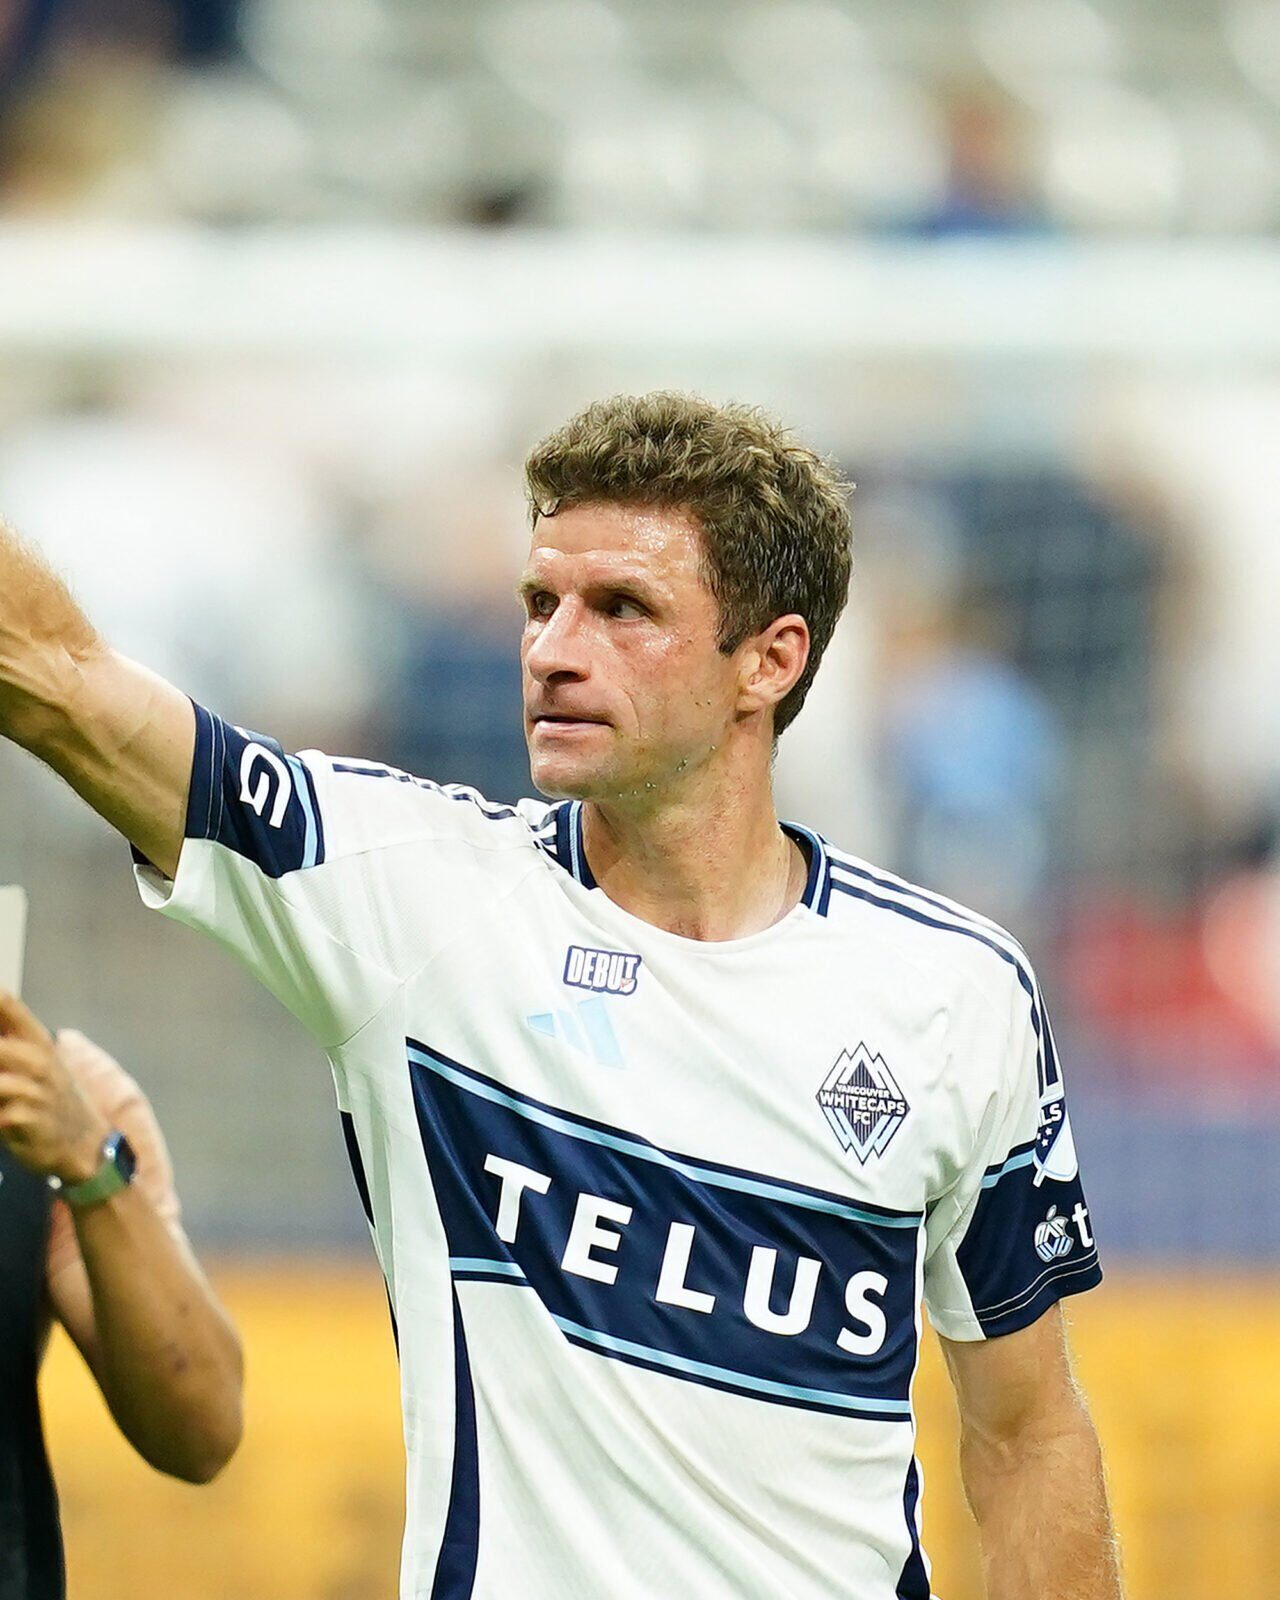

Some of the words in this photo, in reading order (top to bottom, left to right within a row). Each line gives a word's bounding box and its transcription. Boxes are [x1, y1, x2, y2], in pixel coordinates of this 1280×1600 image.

[565, 946, 640, 992] DEBUT
[835, 1083, 892, 1099] VANCOUVER
[820, 1091, 906, 1116] WHITECAPS
[1038, 1103, 1062, 1127] LS
[853, 1111, 871, 1125] FC
[483, 1153, 889, 1356] TELUS
